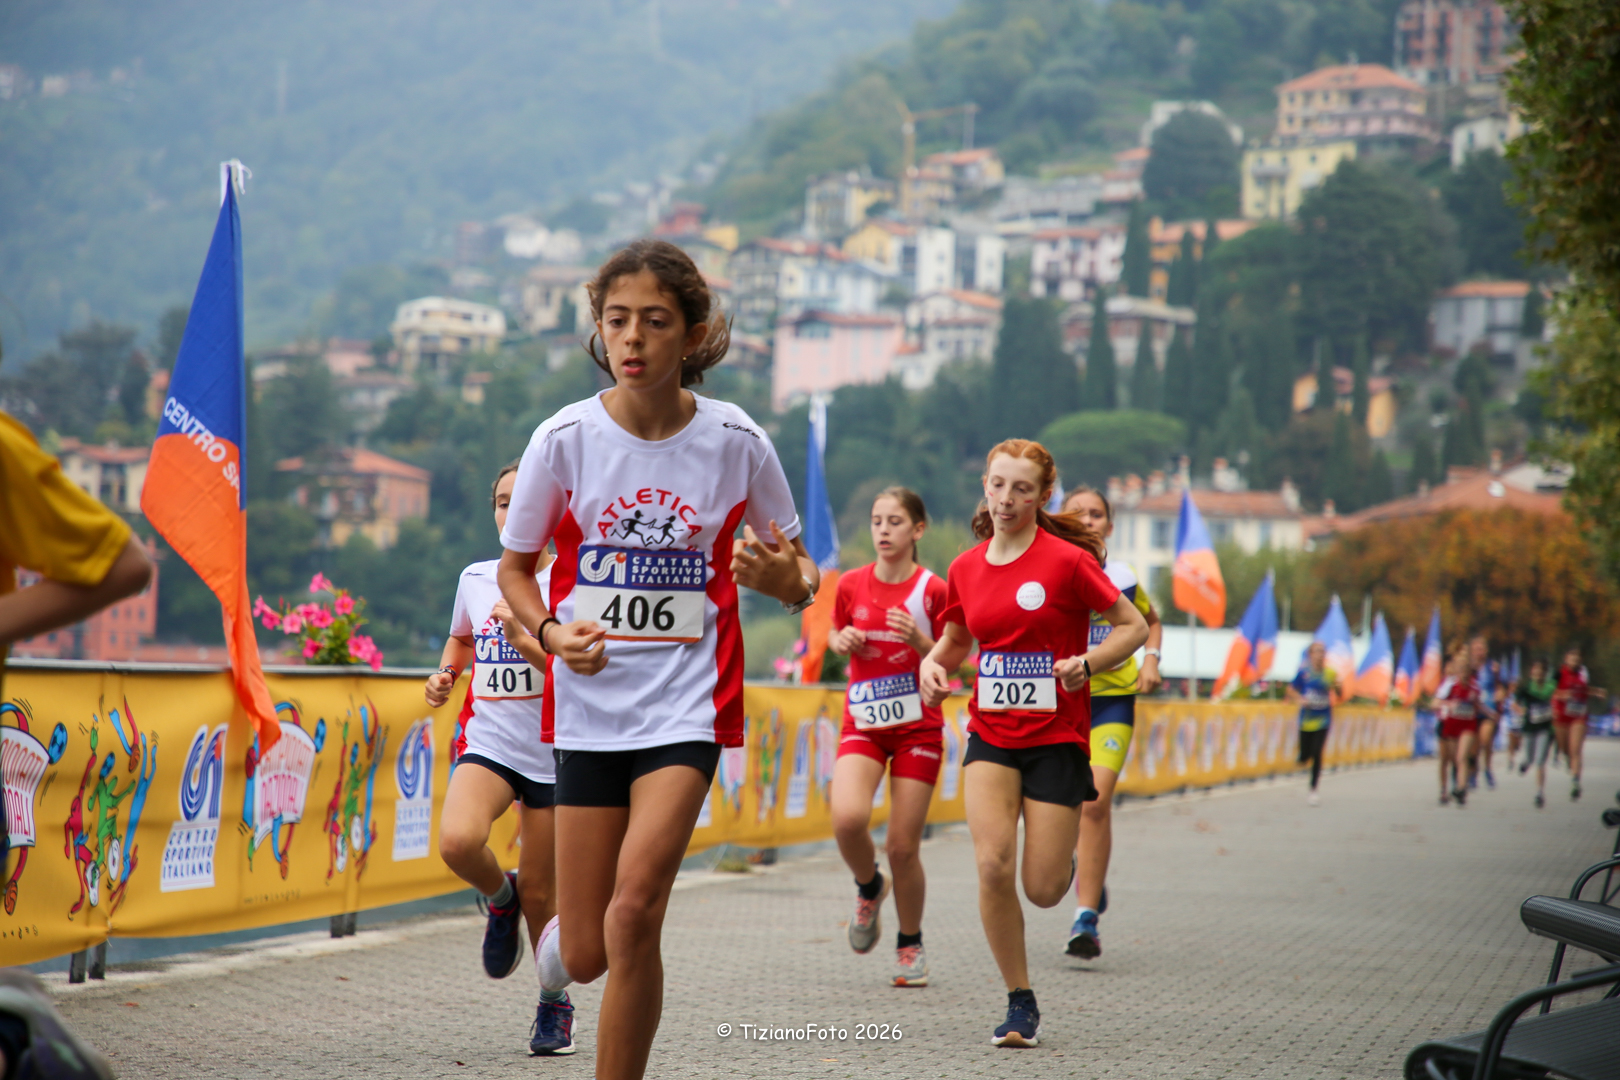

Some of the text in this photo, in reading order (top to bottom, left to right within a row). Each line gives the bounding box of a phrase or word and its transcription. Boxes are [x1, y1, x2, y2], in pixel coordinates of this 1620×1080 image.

[164, 397, 227, 462] CENTRO
[597, 488, 702, 539] ATLETICA
[632, 556, 702, 567] CENTRO
[632, 565, 702, 576] SPORTIVO
[631, 574, 702, 585] ITALIANO
[600, 594, 675, 631] 406
[487, 667, 532, 693] 401
[992, 682, 1038, 705] 202
[865, 701, 904, 724] 300
[169, 828, 217, 846] CENTRO
[164, 845, 213, 862] SPORTIVO
[163, 862, 212, 879] ITALIANO
